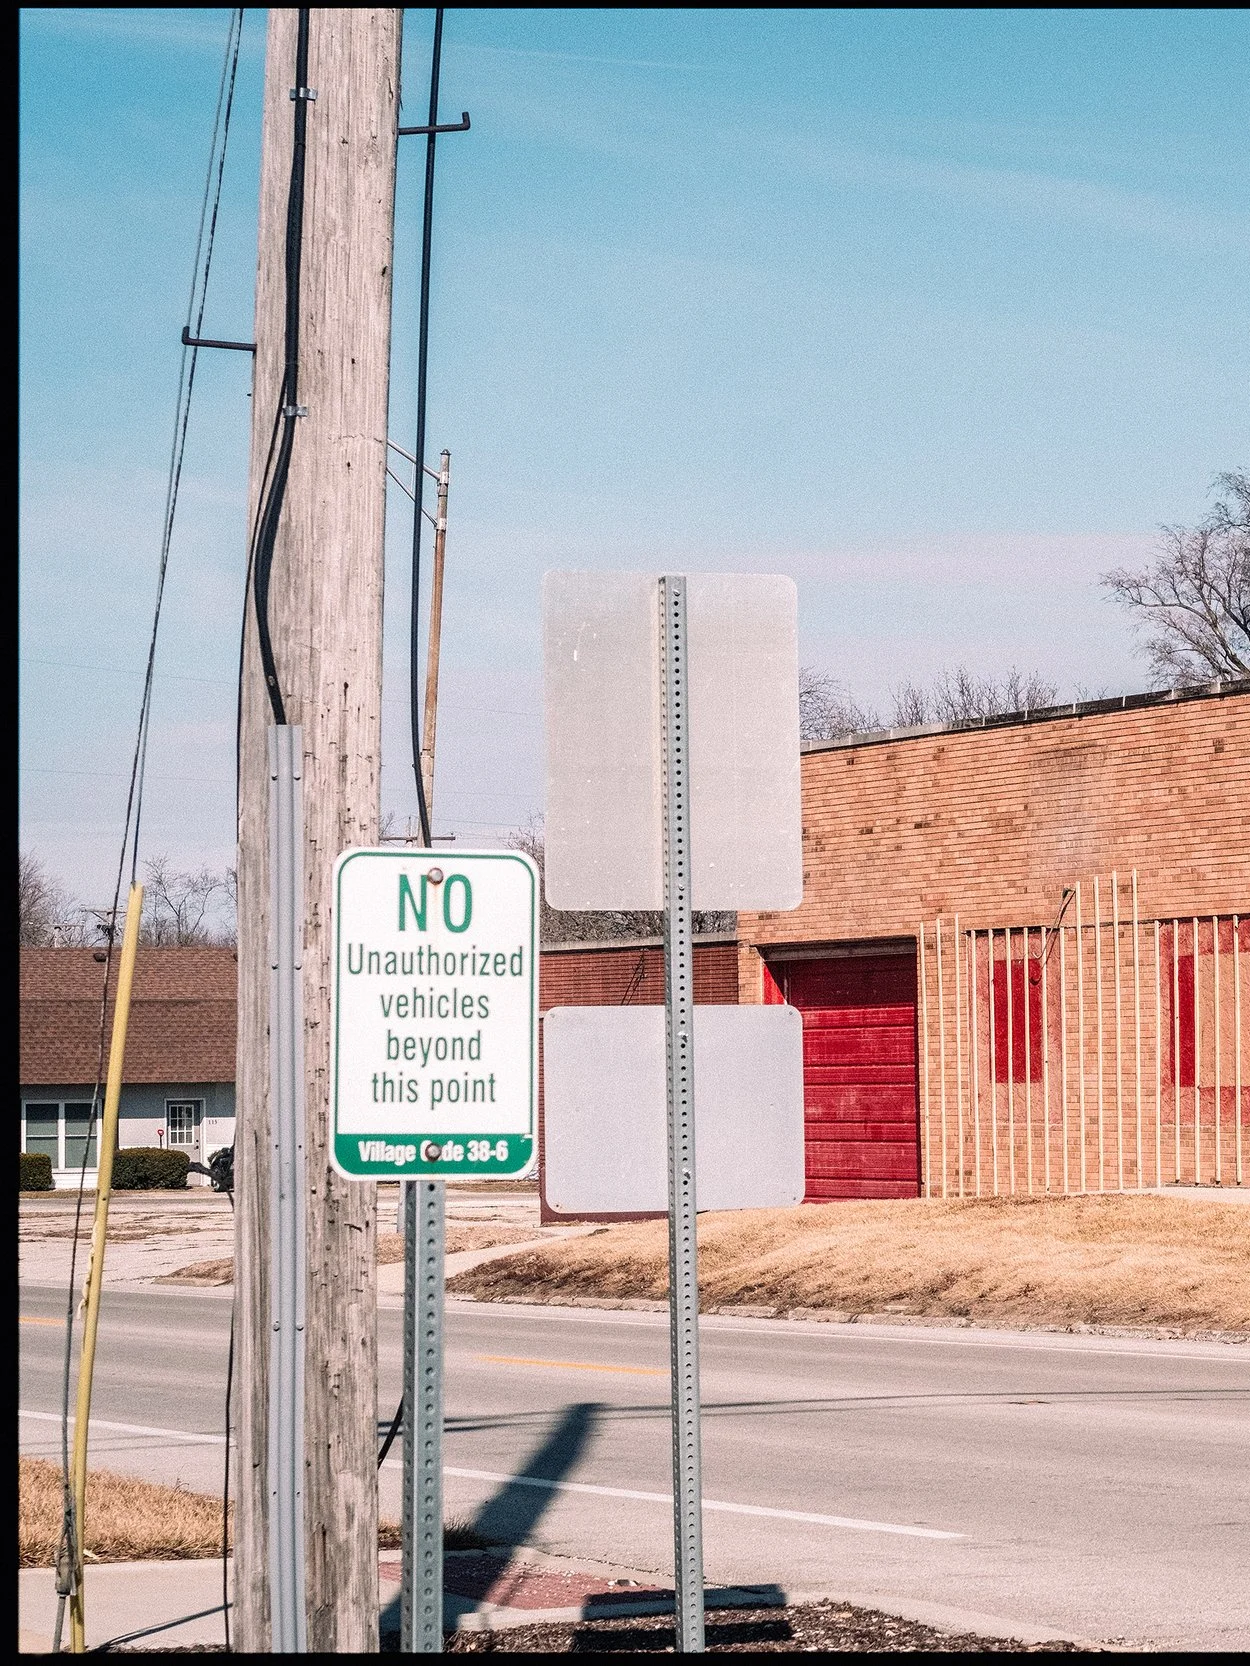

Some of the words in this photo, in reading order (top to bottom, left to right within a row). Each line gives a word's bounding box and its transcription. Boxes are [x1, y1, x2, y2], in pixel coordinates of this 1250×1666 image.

[398, 873, 473, 934] NO
[347, 943, 524, 977] Unauthorized
[380, 987, 490, 1019] vehicles
[386, 1029, 481, 1068] beyond
[371, 1071, 419, 1103] this
[430, 1073, 497, 1111] point
[357, 1140, 417, 1166] Village
[420, 1140, 465, 1162] Cde
[467, 1140, 509, 1162] 38-6
